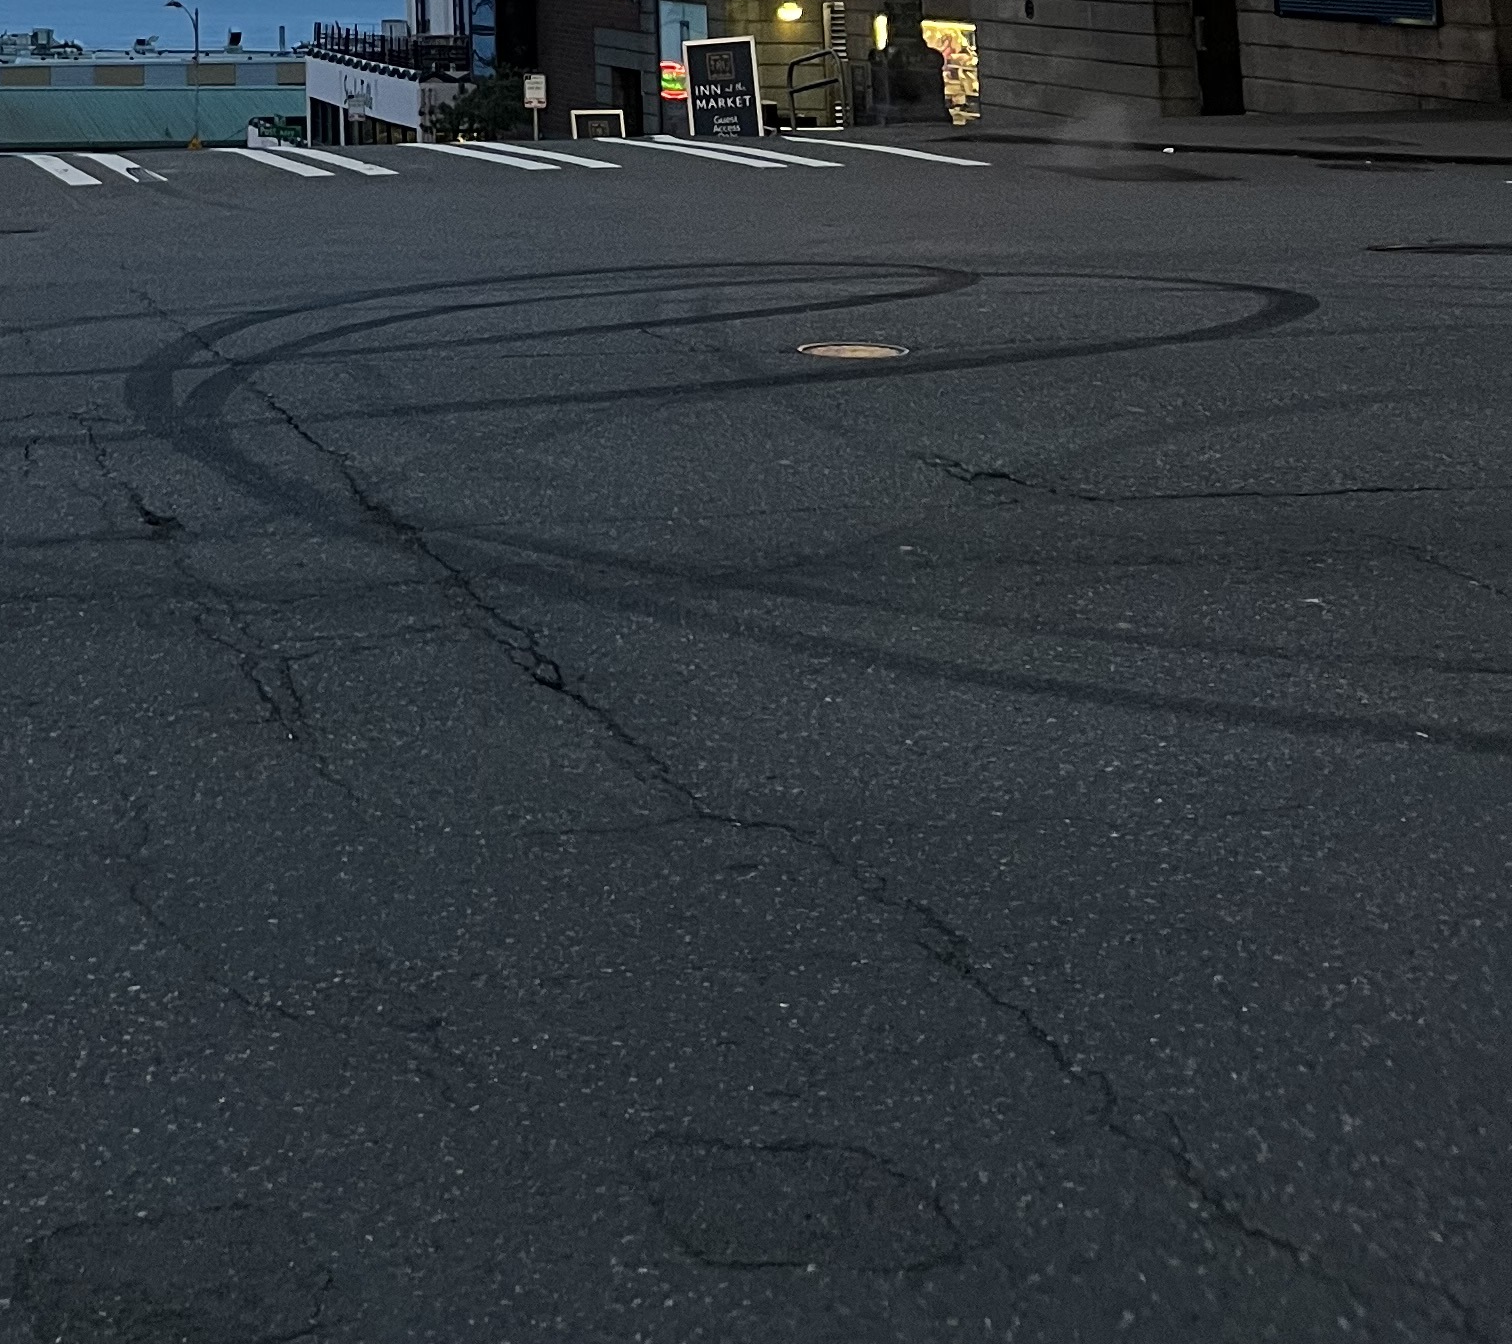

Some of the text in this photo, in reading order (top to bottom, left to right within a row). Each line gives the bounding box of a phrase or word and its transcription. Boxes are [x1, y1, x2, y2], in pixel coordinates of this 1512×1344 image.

[694, 83, 721, 97] INN
[696, 95, 752, 110] MARKET
[713, 115, 739, 124] Guest
[713, 124, 741, 133] Access
